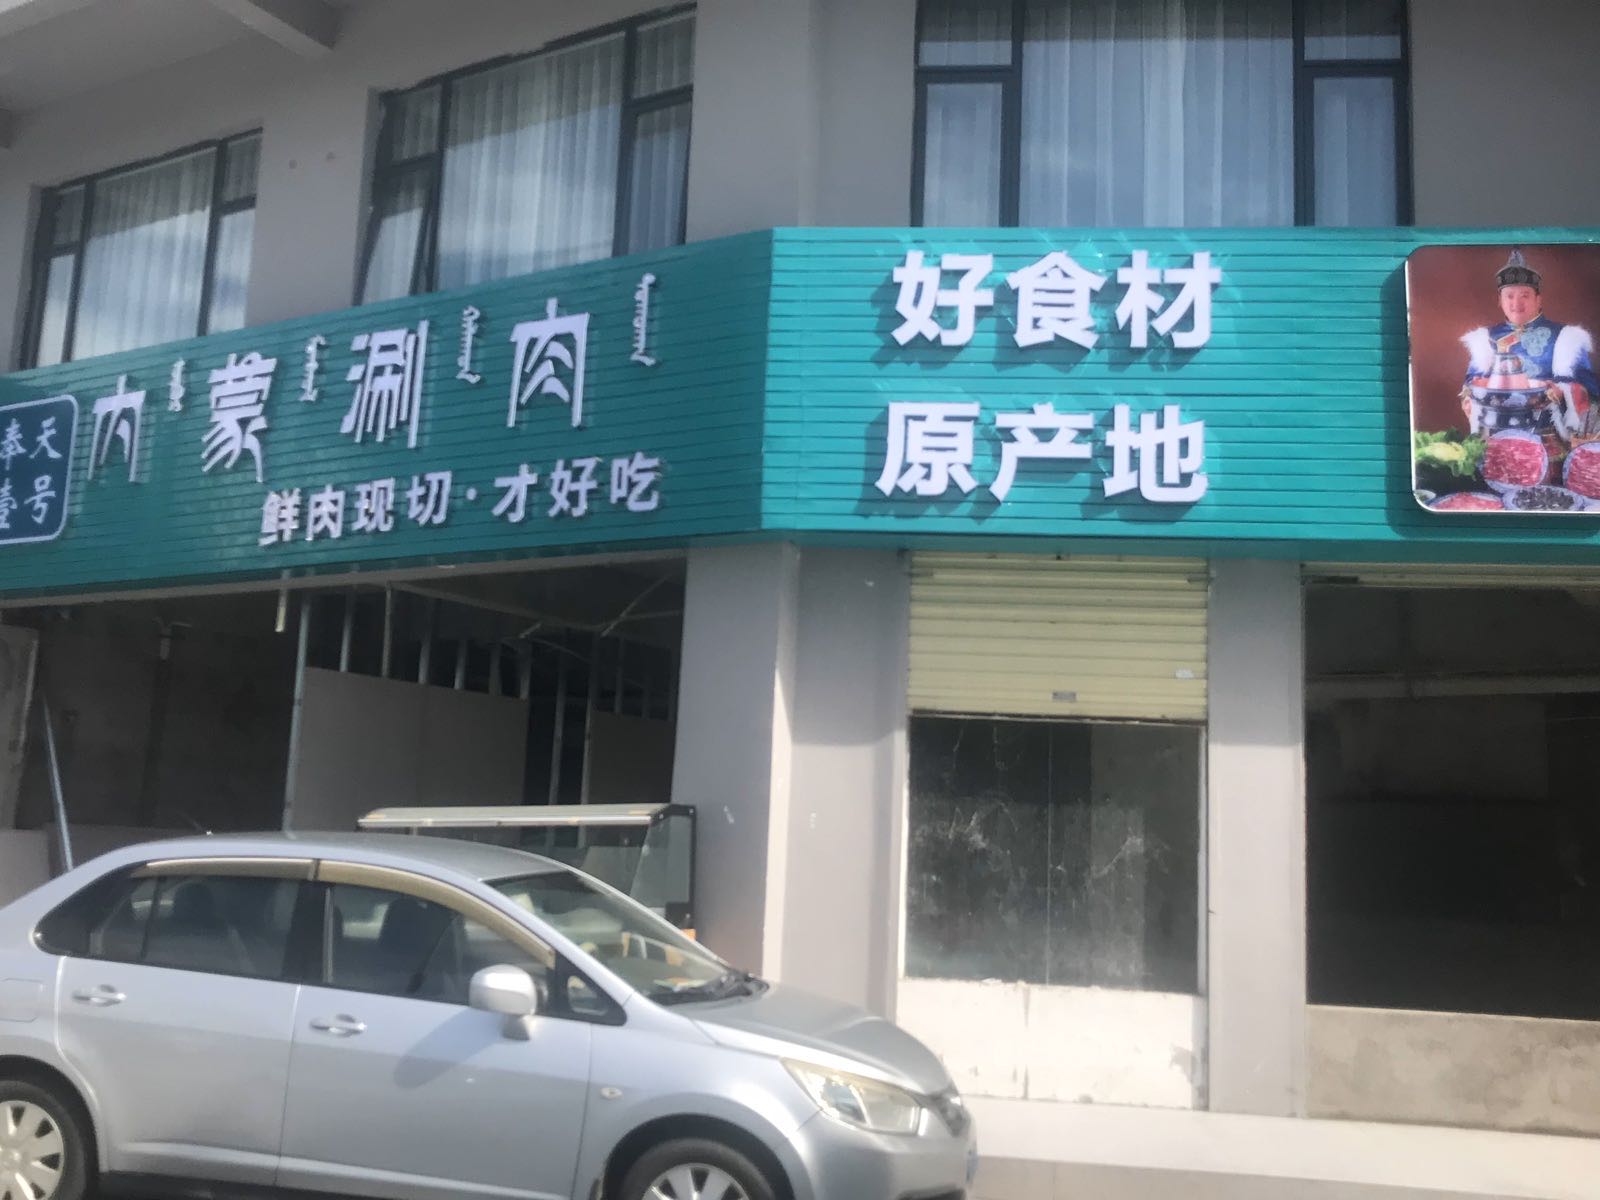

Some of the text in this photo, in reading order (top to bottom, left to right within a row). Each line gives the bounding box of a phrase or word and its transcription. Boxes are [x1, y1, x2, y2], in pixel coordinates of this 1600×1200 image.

[891, 249, 1222, 350] 好食材
[87, 297, 591, 483] 内蒙涮肉
[875, 402, 1209, 504] 原产地
